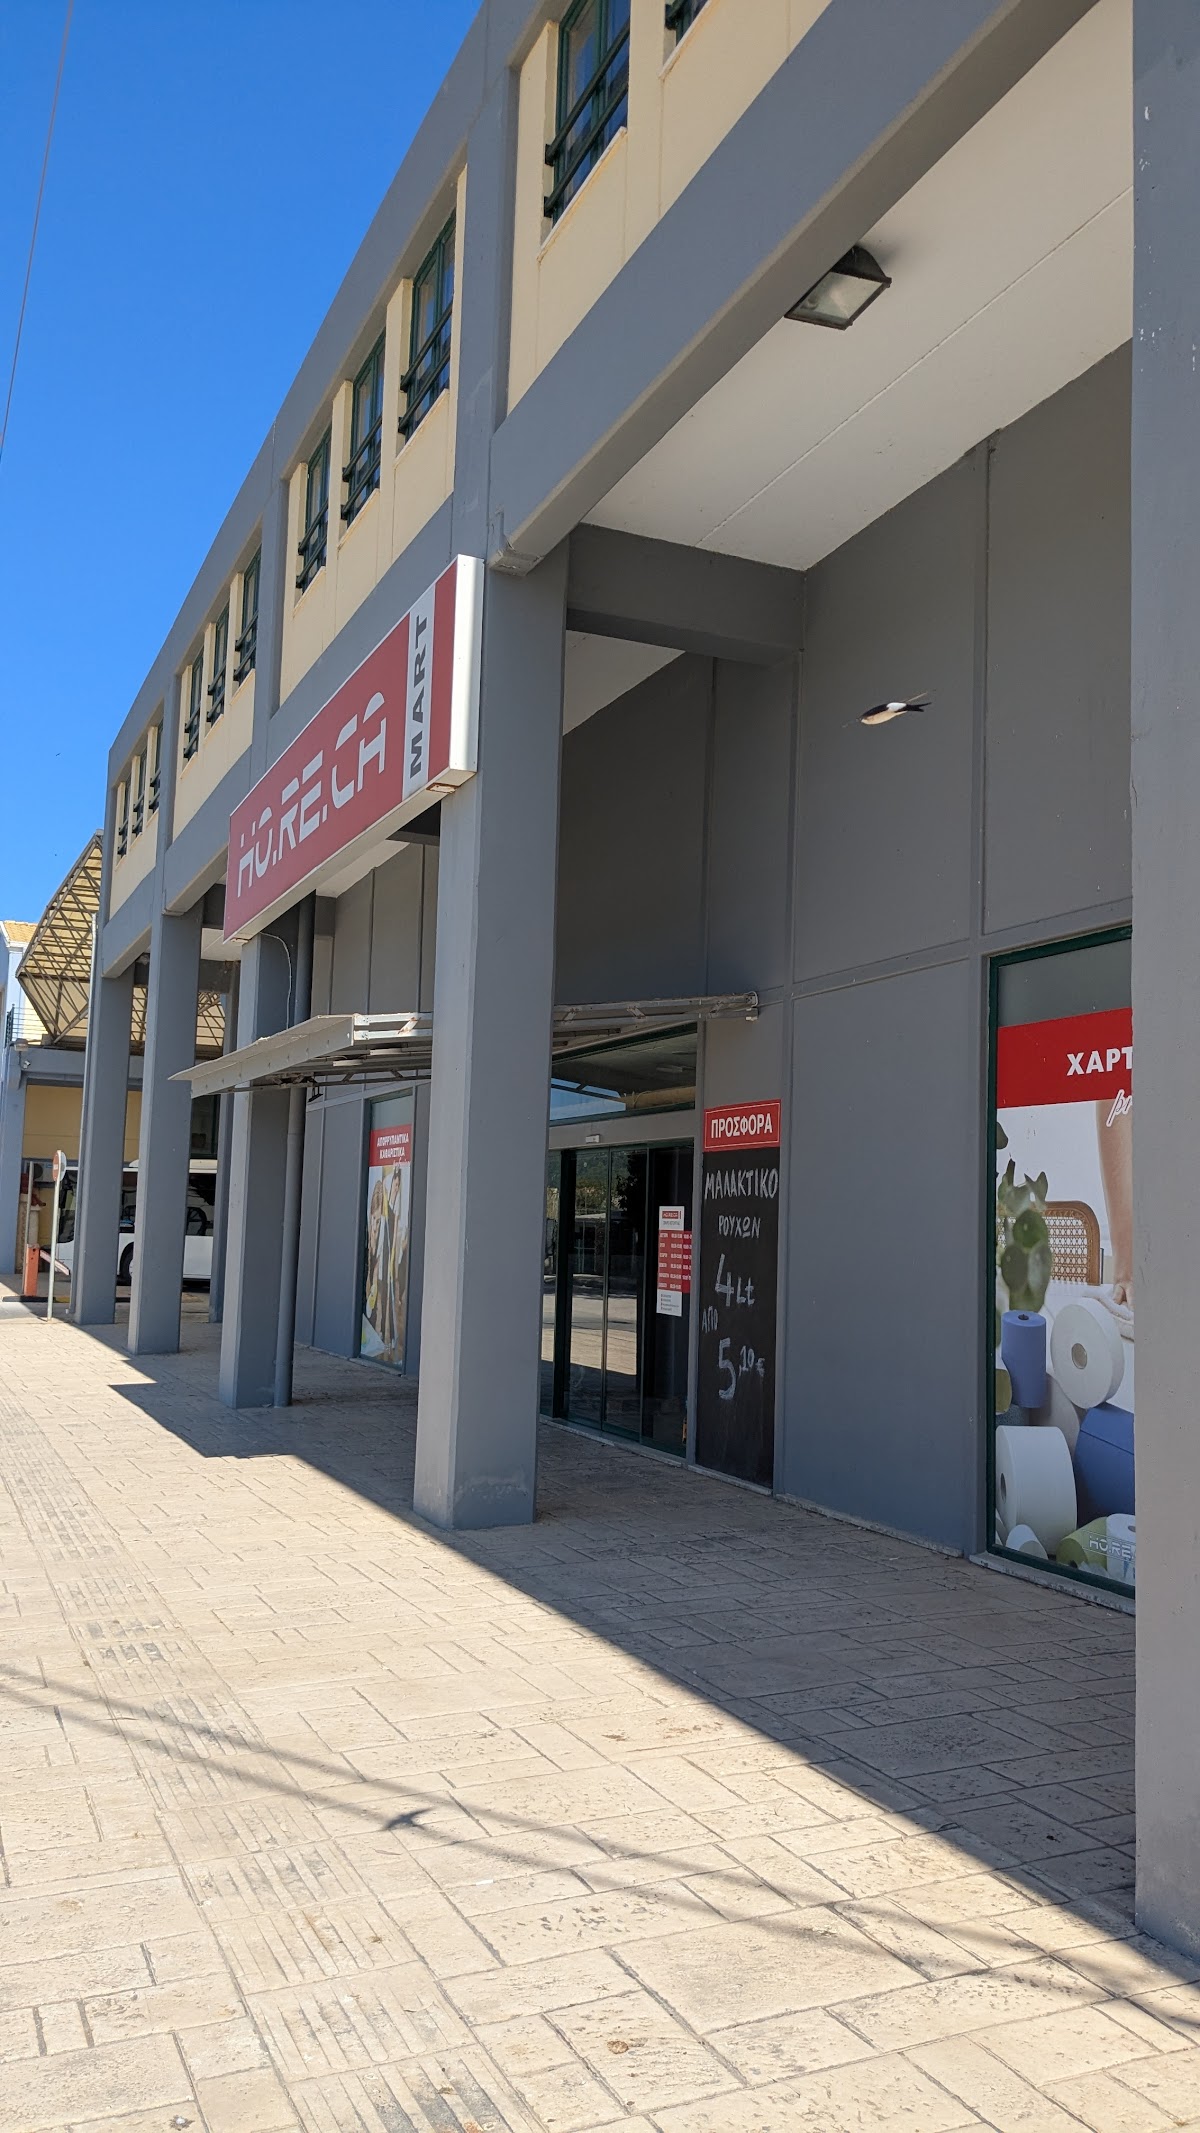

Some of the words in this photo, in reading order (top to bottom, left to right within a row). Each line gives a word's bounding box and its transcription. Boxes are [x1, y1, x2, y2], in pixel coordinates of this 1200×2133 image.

[409, 614, 428, 780] MART
[711, 1113, 773, 1138] ΠΡΟΣΦΟΡΑ
[704, 1168, 779, 1200] ΜΑΛΑΚΤΙΚΟ
[718, 1214, 761, 1239] ΡΟΥΧΩΝ
[702, 1305, 719, 1334] ΑΠΟ
